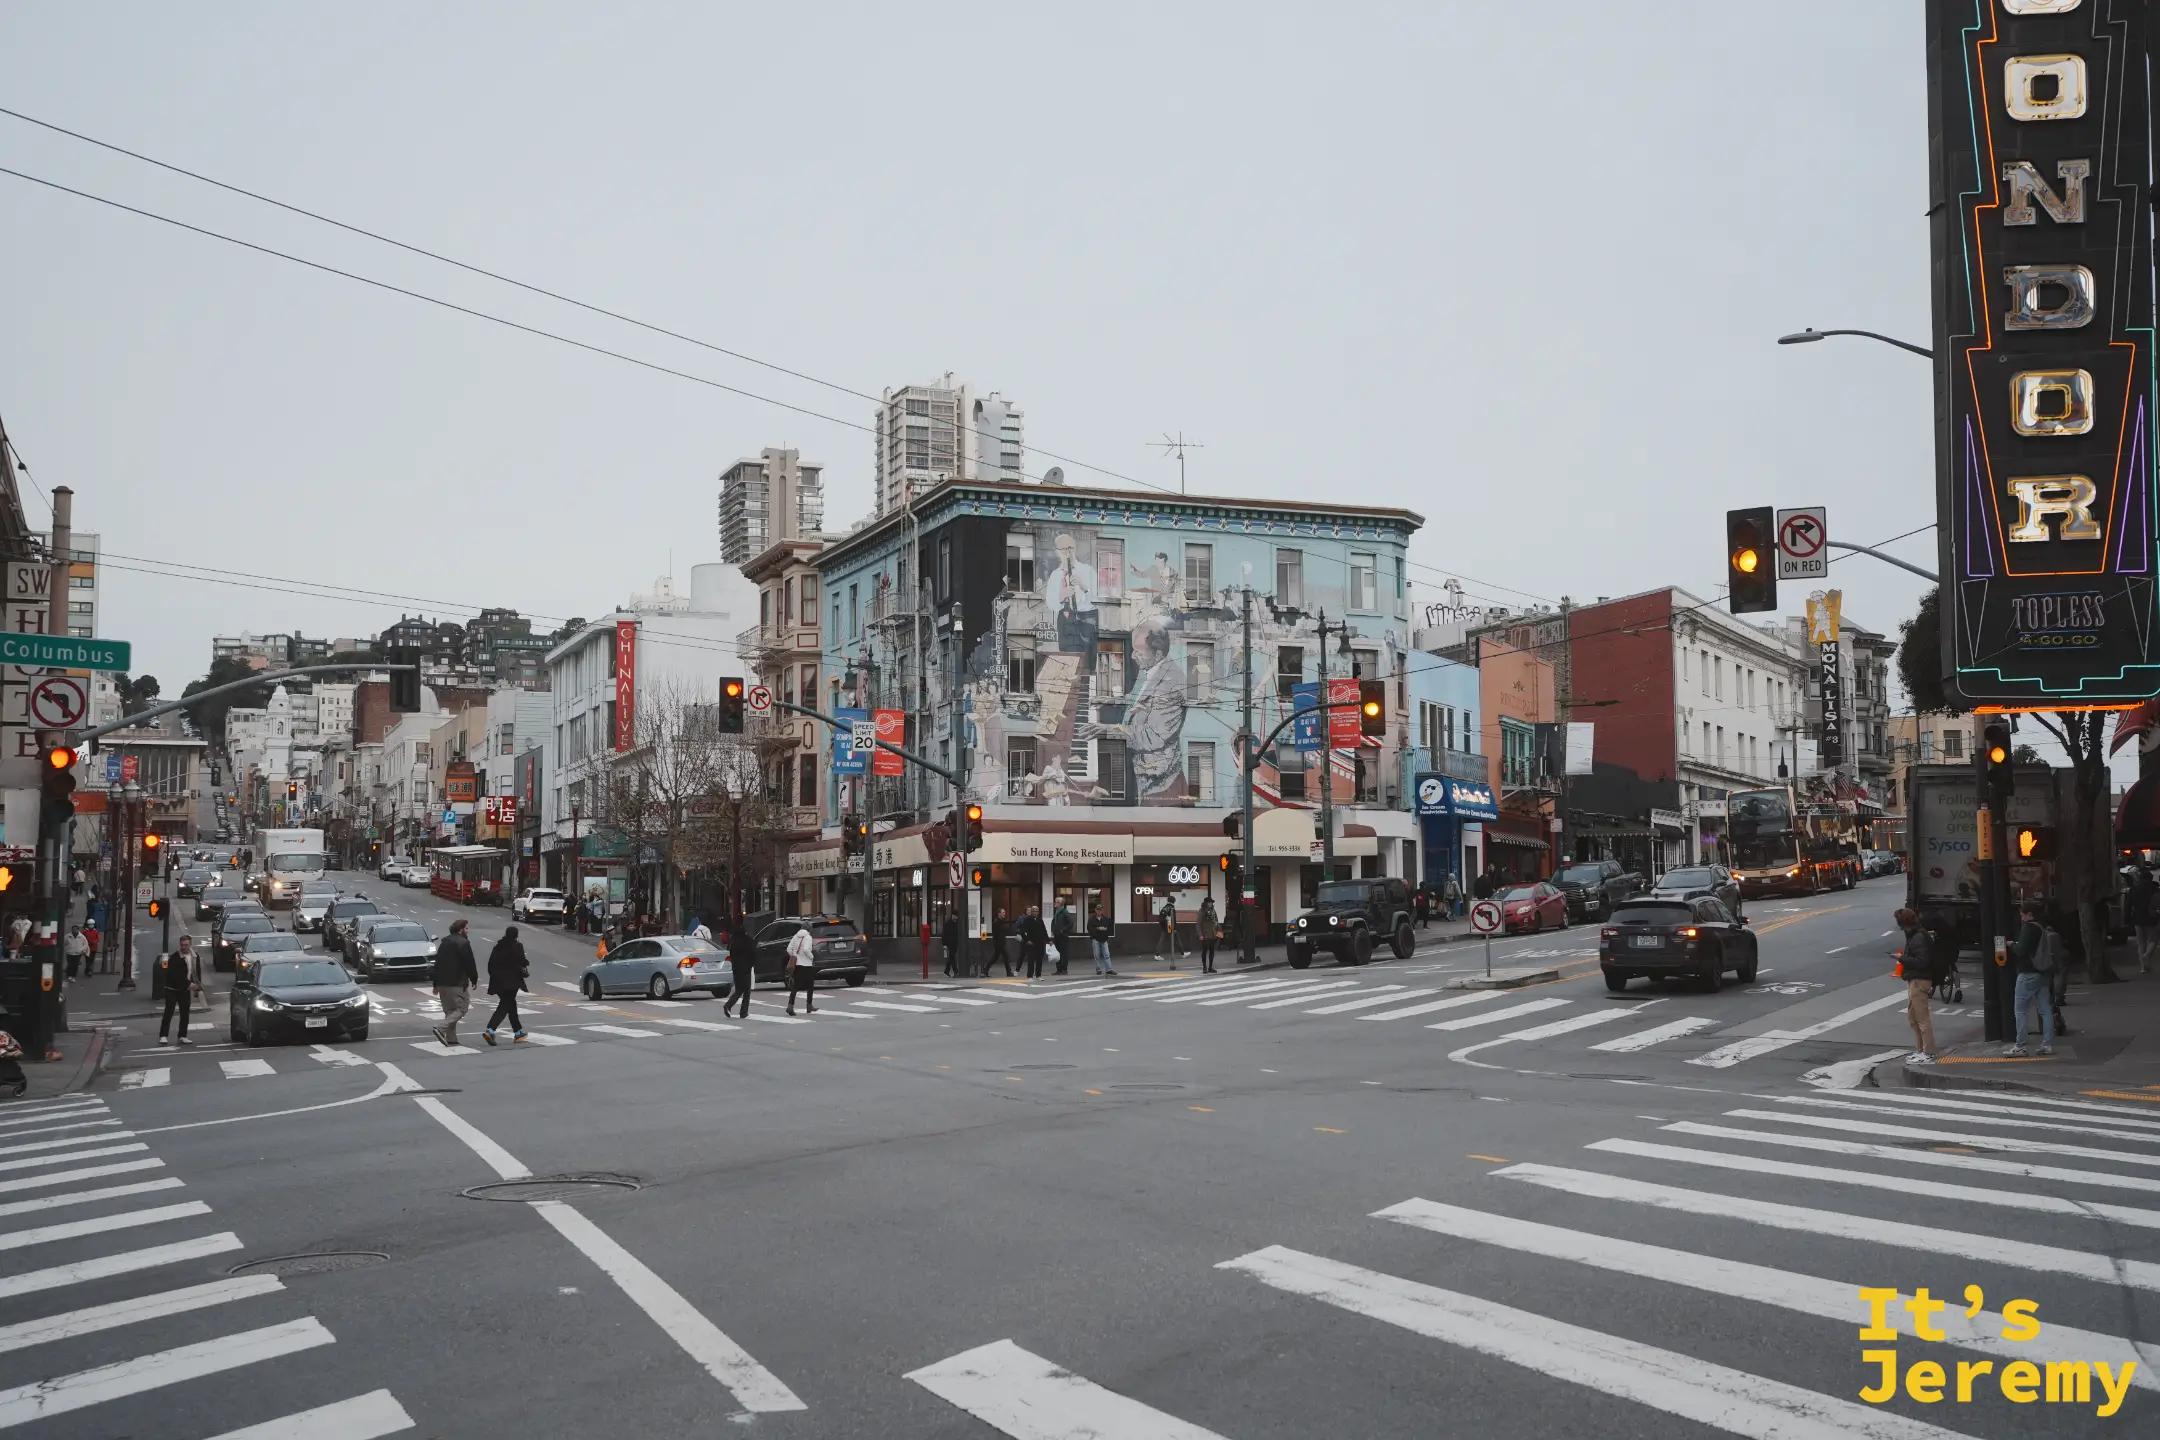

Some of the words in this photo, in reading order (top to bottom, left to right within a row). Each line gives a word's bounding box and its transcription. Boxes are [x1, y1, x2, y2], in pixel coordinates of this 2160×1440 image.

[2001, 0, 2101, 542] ONDOR
[1784, 561, 1798, 573] ON
[1801, 560, 1822, 572] RED
[17, 568, 50, 594] SW
[2011, 595, 2105, 629] TOPLESS
[3, 640, 115, 664] Columbus
[1822, 642, 1837, 684] MONA
[1824, 690, 1838, 731] LISA
[854, 737, 873, 748] 20
[1825, 736, 1839, 744] #3
[1938, 794, 1977, 805] Follo
[1950, 809, 1977, 820] you
[1946, 823, 1977, 834] grea
[1928, 838, 1970, 854] Sysco
[1010, 847, 1028, 857] Sun
[1030, 847, 1054, 858] Hong
[1056, 848, 1079, 859] Kong
[1081, 849, 1127, 858] Restaurant
[813, 859, 824, 871] Hong
[825, 858, 836, 869] Kong
[1168, 866, 1200, 884] 606
[1135, 886, 1154, 895] OPEN
